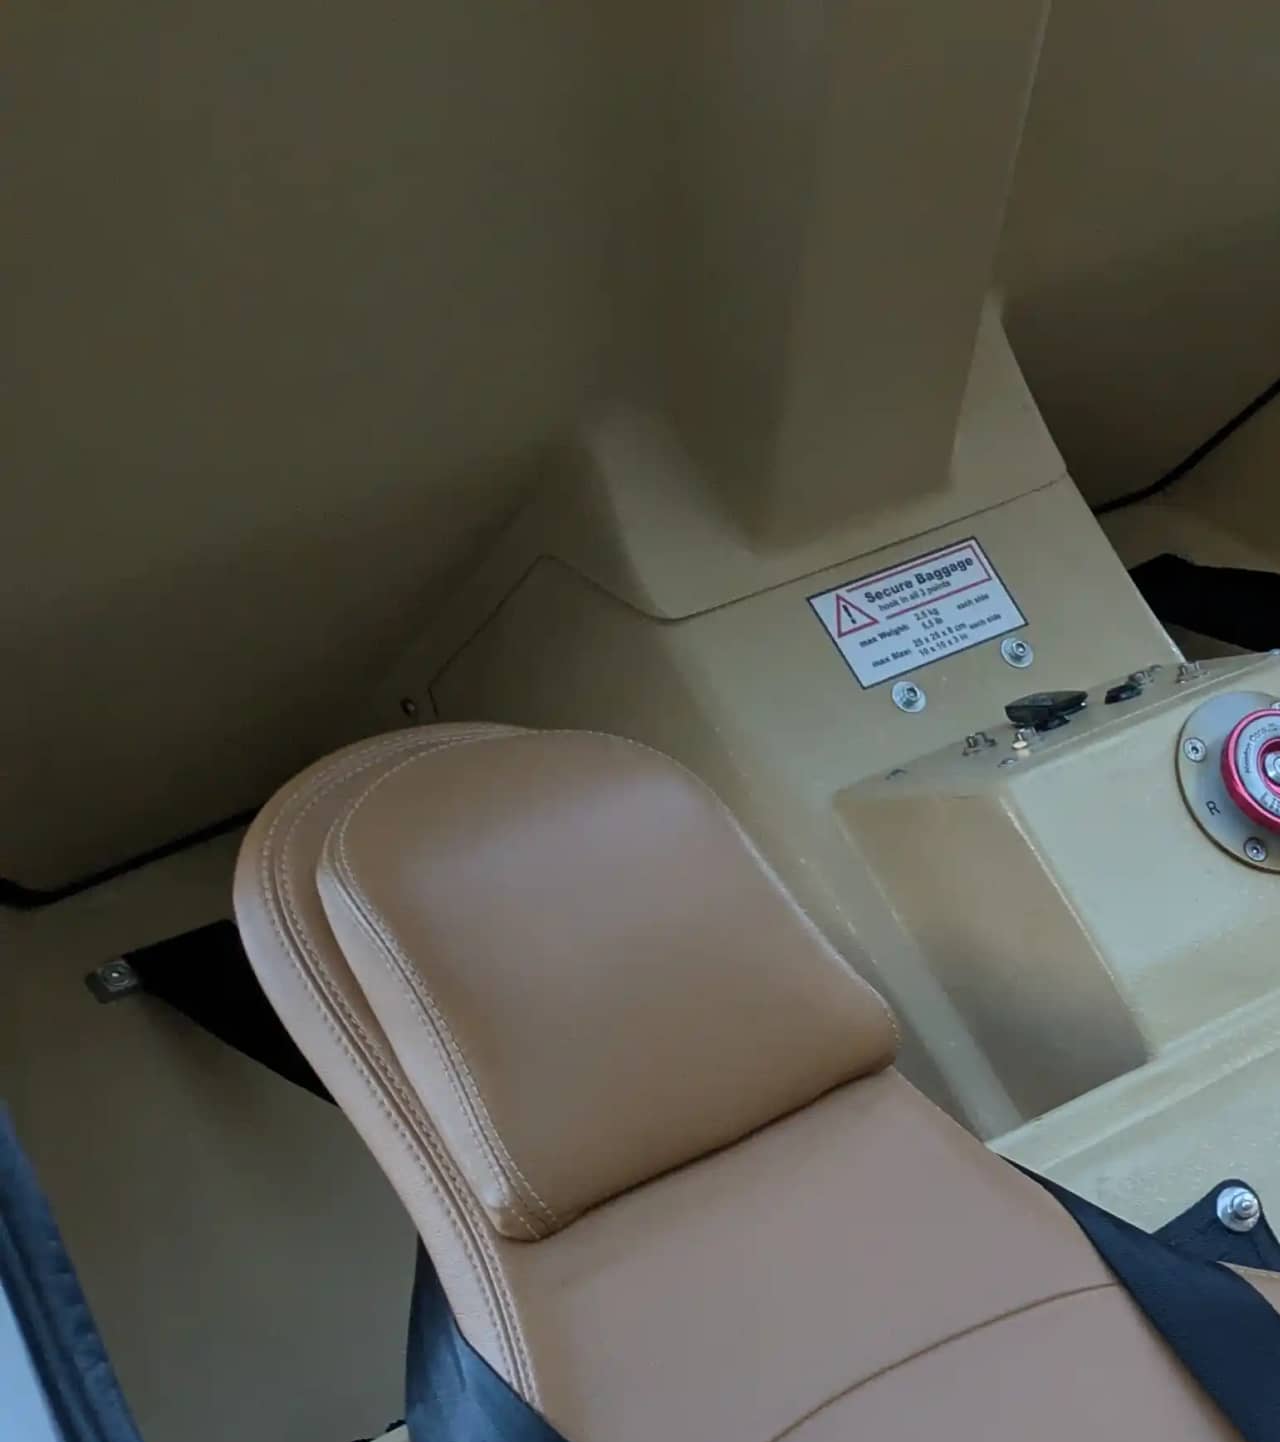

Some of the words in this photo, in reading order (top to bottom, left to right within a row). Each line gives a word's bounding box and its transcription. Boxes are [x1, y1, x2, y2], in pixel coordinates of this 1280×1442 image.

[864, 580, 913, 603] Secure
[914, 557, 974, 584] Baggage
[878, 599, 899, 611] hook
[900, 596, 908, 604] in
[909, 590, 919, 600] all
[927, 581, 951, 595] points
[927, 607, 940, 618] kg
[859, 636, 878, 648] max
[871, 656, 891, 668] max
[1205, 800, 1221, 816] R
